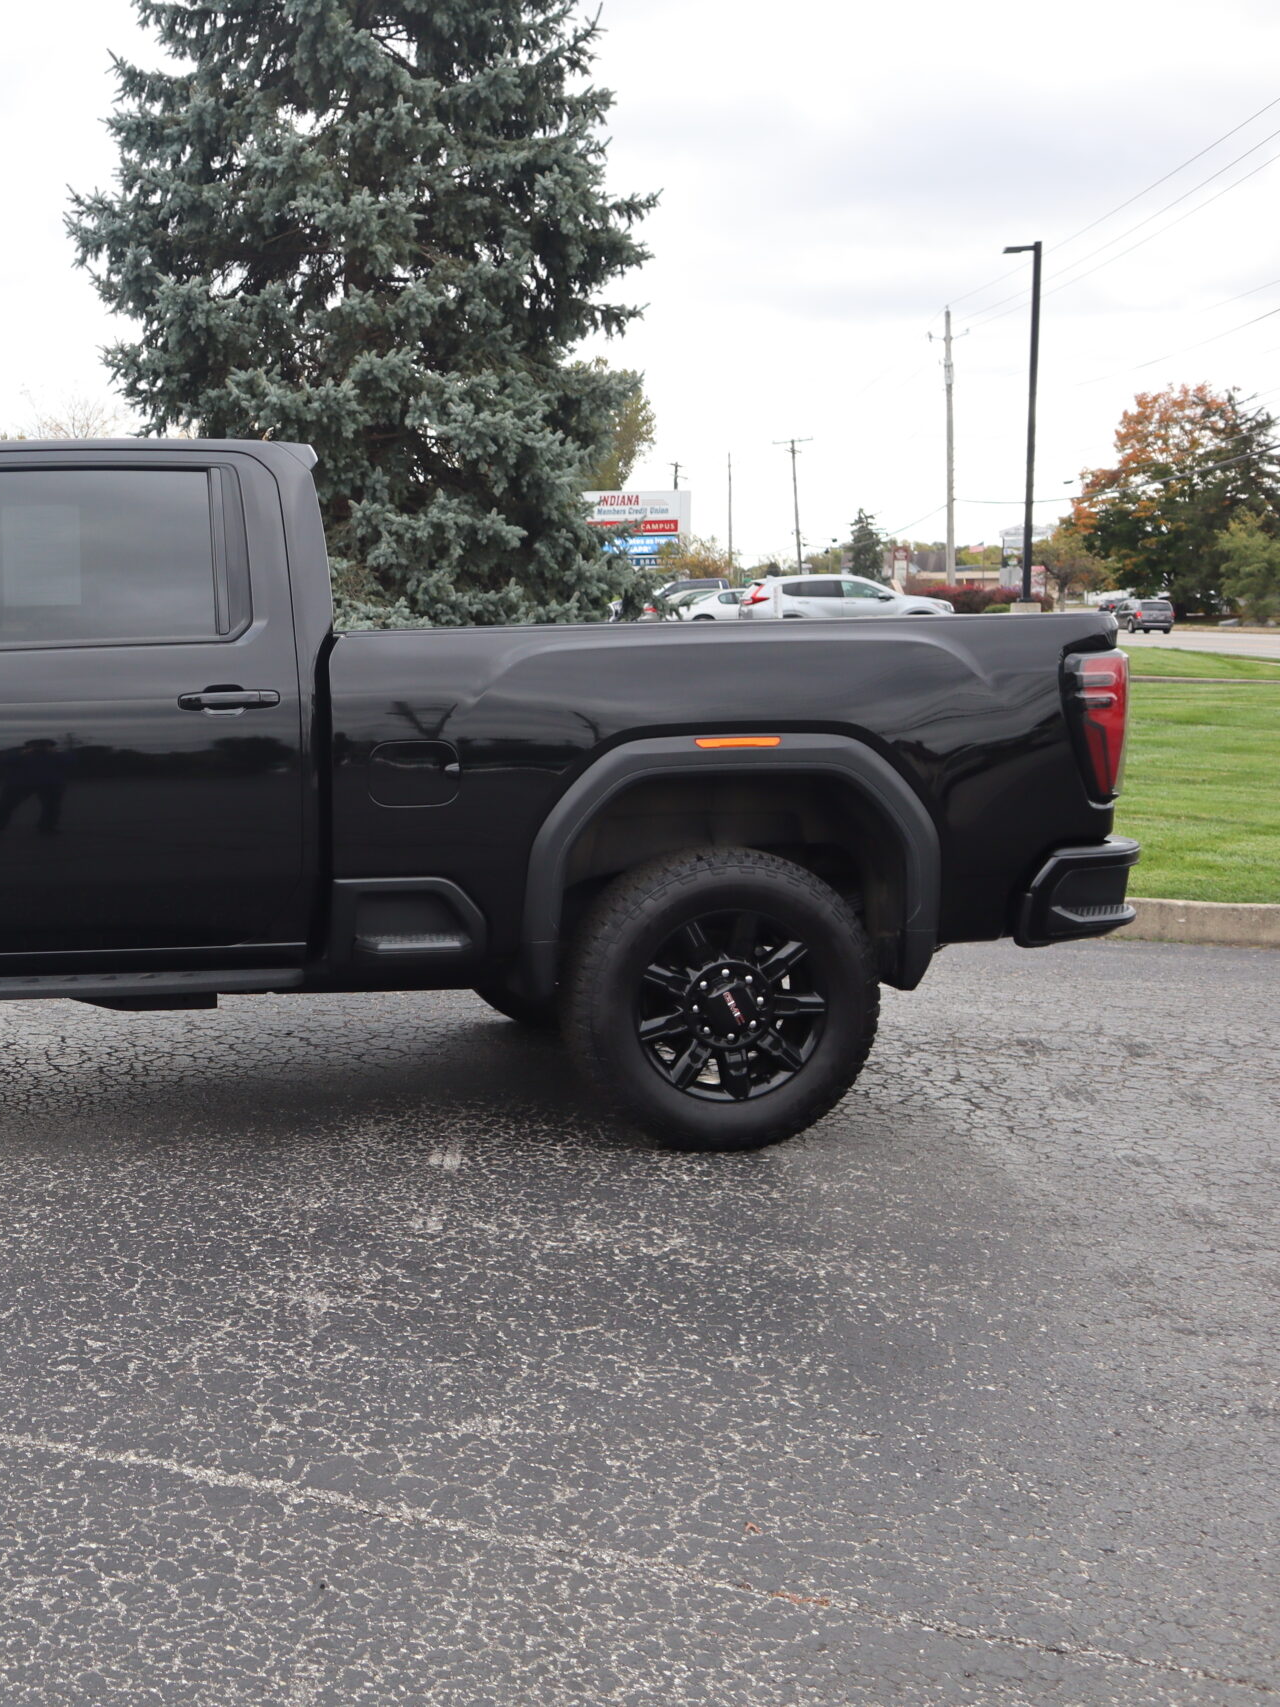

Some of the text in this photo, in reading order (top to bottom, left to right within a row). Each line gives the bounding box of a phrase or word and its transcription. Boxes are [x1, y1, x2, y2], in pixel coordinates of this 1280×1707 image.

[598, 495, 639, 506] INDIANA
[597, 506, 669, 515] Members Credit Union
[641, 523, 675, 531] CAMPUS
[723, 991, 746, 1026] GMC
